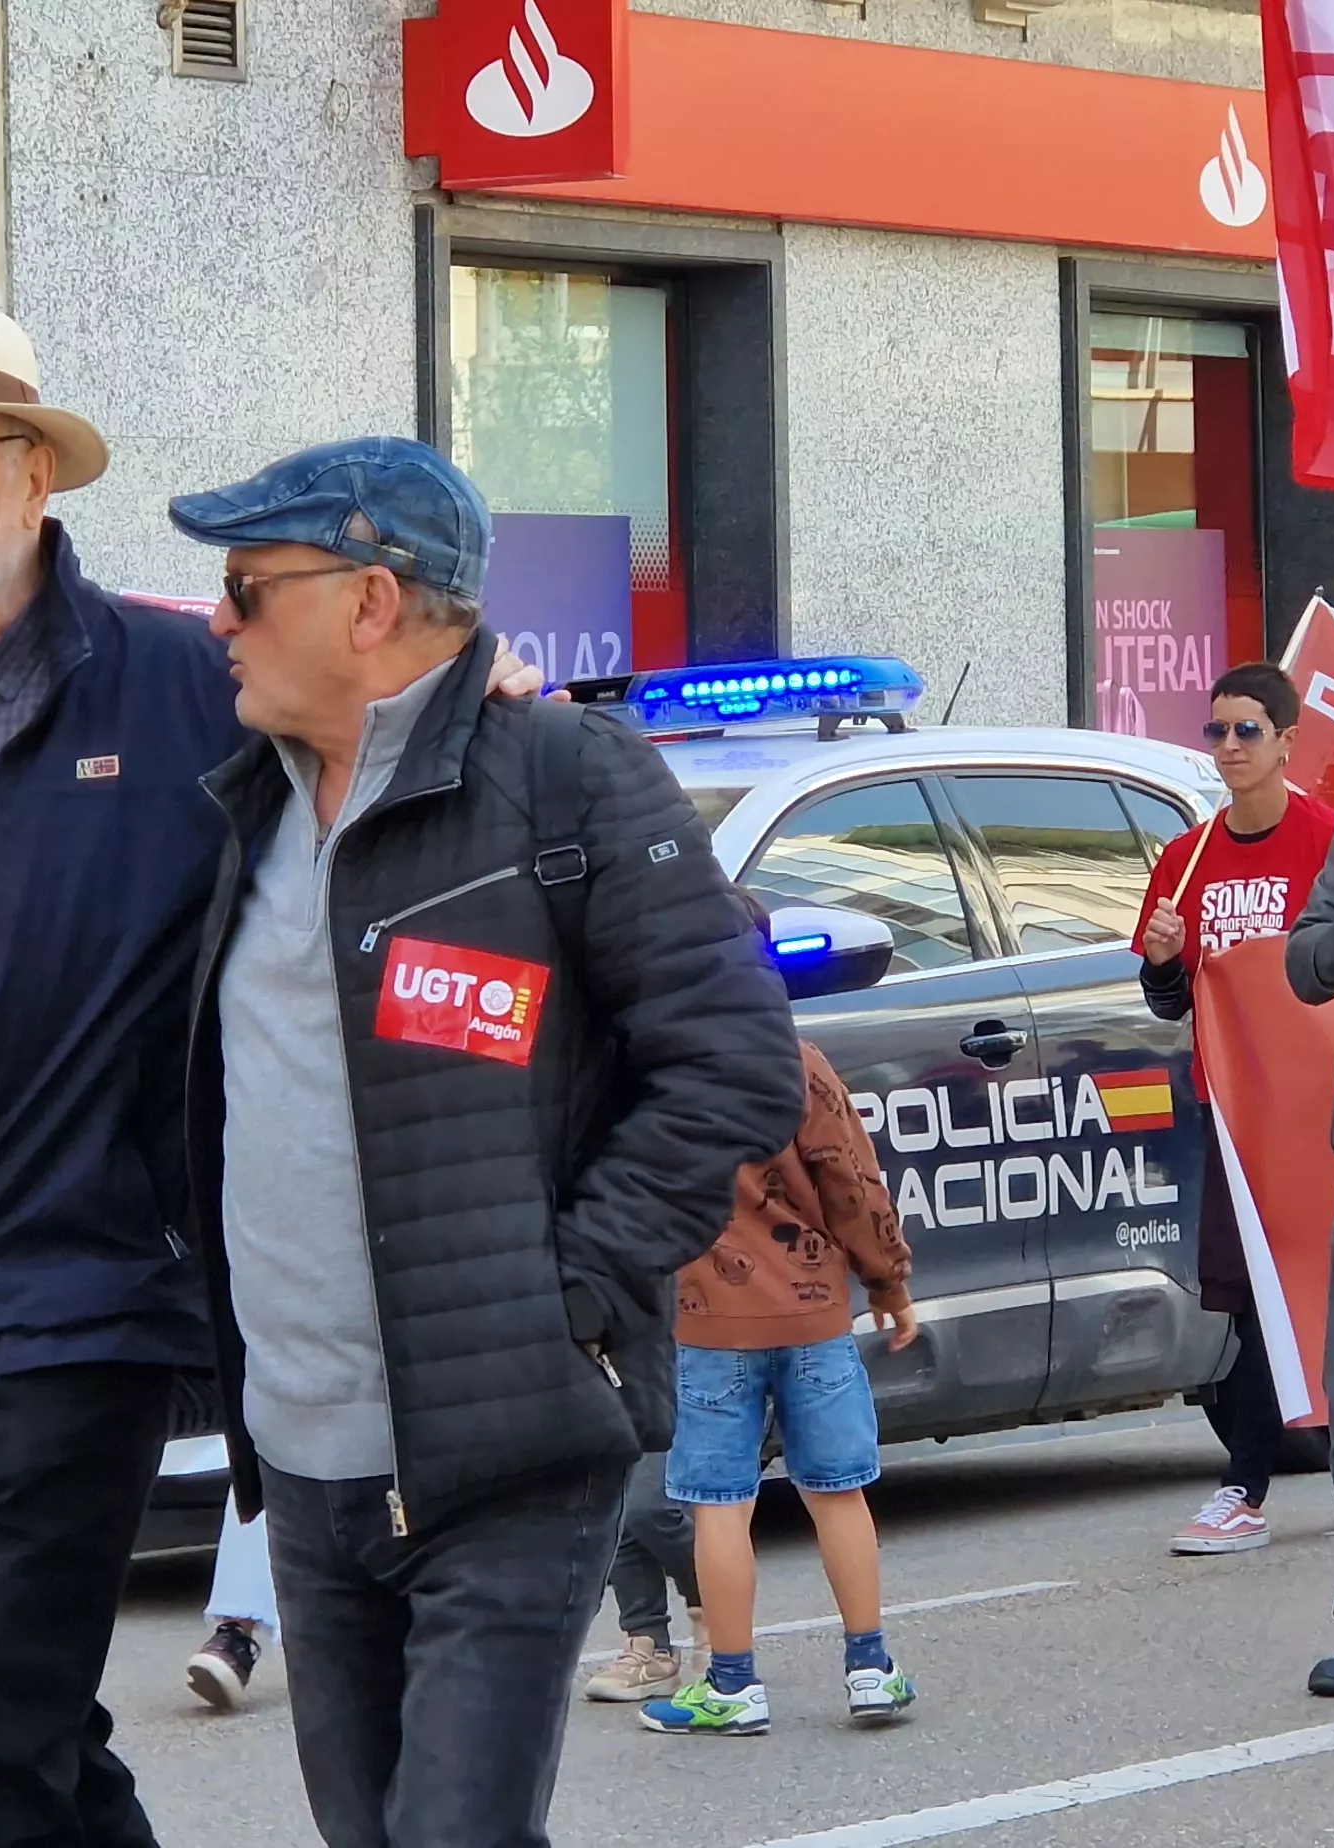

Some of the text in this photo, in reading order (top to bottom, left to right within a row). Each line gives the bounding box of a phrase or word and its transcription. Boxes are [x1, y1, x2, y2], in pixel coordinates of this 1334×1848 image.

[1113, 600, 1172, 630] SHOCK
[1097, 634, 1217, 692] ITERAL
[1201, 881, 1288, 921] SOMOS
[1199, 921, 1210, 934] EL
[392, 962, 478, 1009] UGT
[467, 1016, 522, 1043] Aragón
[880, 1146, 1178, 1230] ACIONAL
[1116, 1217, 1181, 1252] @policia
